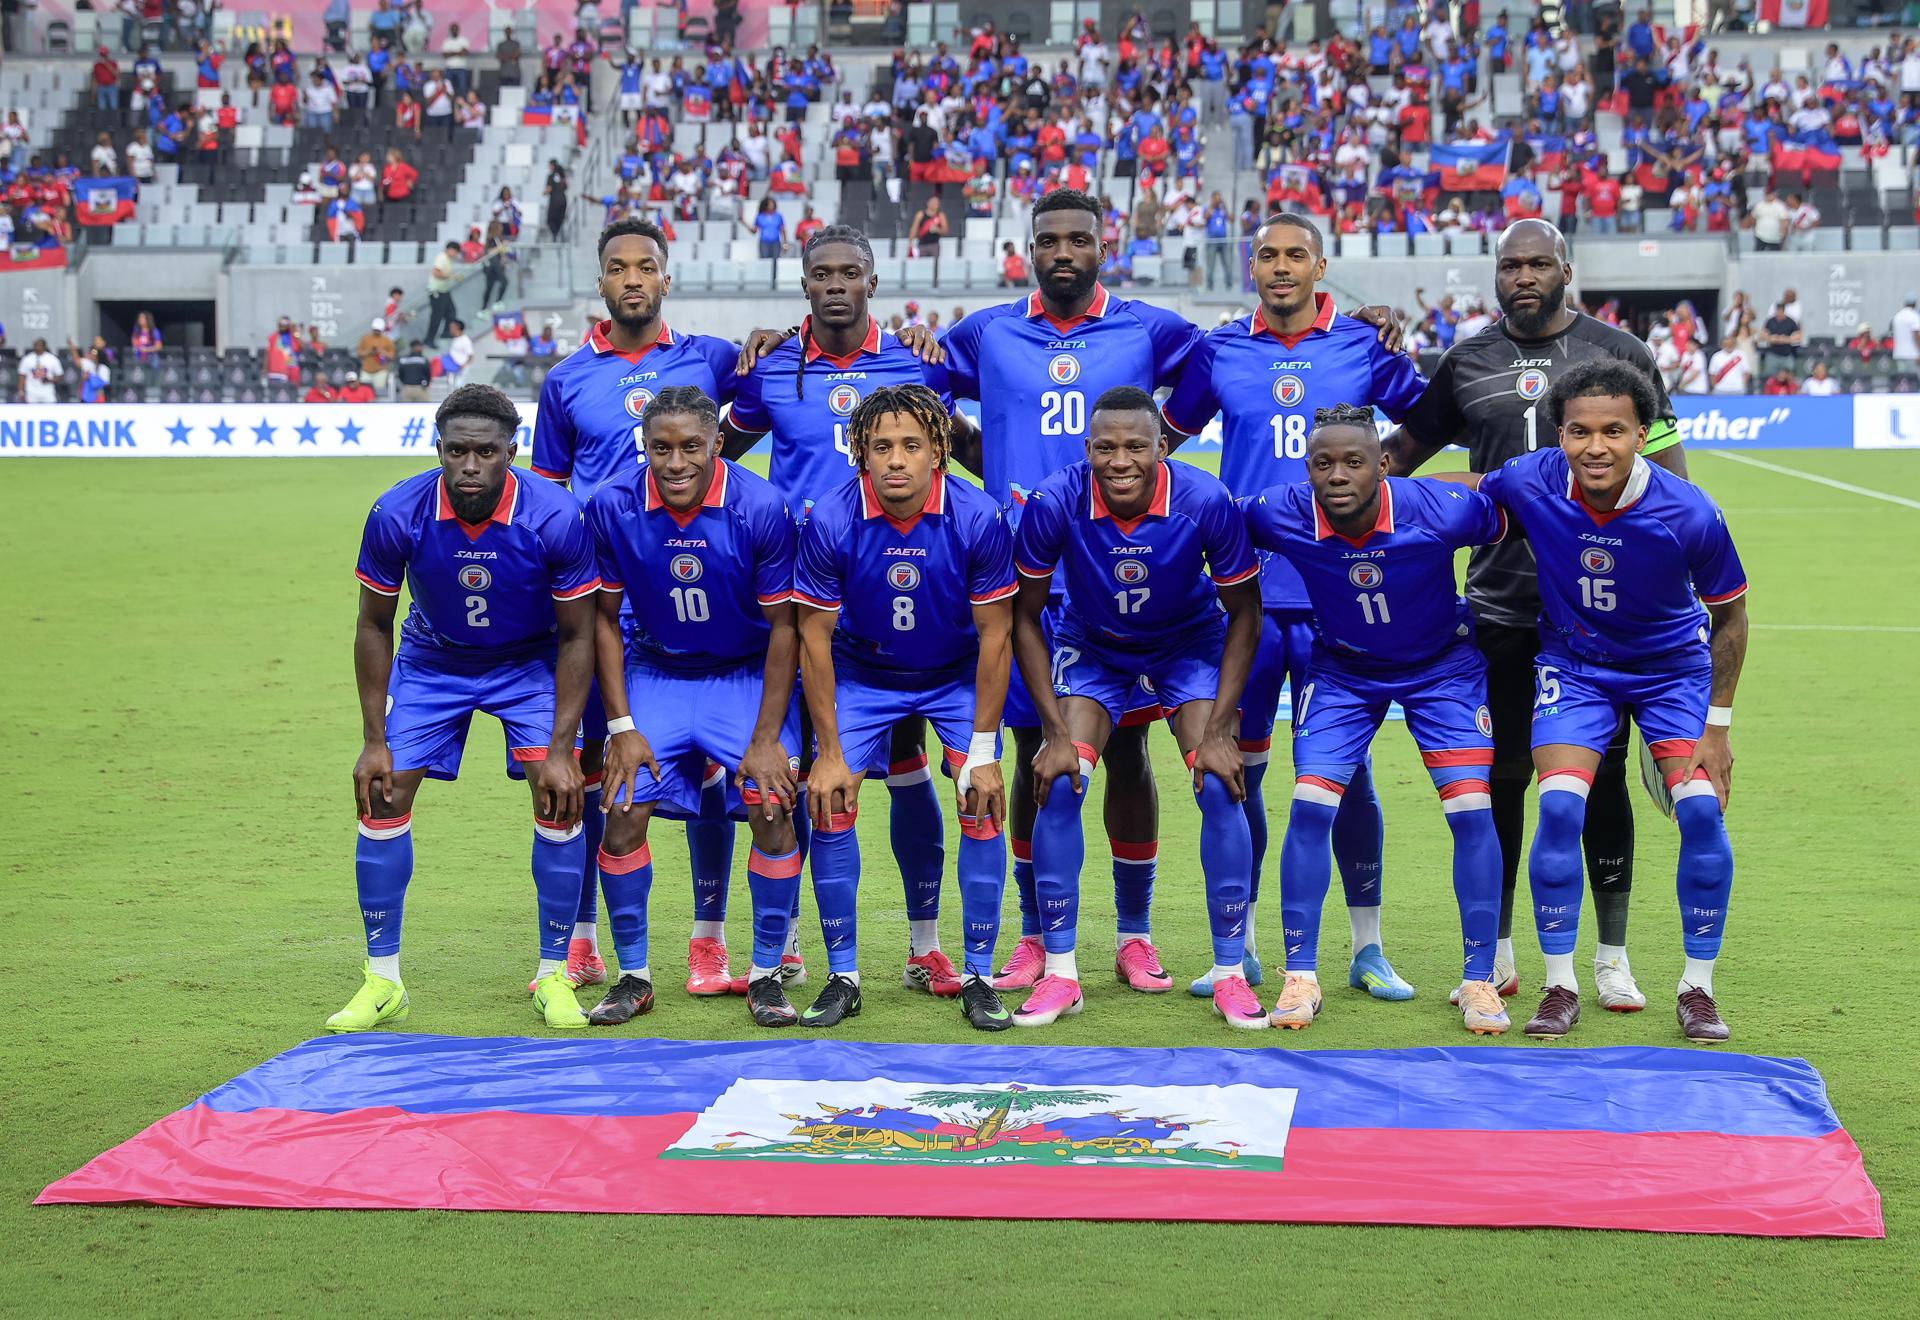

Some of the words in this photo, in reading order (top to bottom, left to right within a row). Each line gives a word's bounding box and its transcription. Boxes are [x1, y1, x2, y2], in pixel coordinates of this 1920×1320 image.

[1829, 308, 1859, 327] 120
[1045, 341, 1087, 349] SAETA
[1269, 361, 1312, 370] SAETA
[1509, 358, 1552, 368] SAETA
[617, 371, 658, 387] SAETA
[824, 372, 867, 381] SAETA
[1040, 391, 1085, 436] 20
[1, 420, 137, 447] NIBANK
[1523, 406, 1537, 451] 1
[1269, 414, 1307, 459] 18
[664, 539, 707, 548] SAETA
[1578, 533, 1623, 546] SAETA
[883, 547, 927, 557] SAETA
[1108, 545, 1153, 555] SAETA
[1341, 549, 1386, 559] SAETA
[453, 551, 498, 560] SAETA
[1577, 576, 1617, 612] 15
[669, 587, 710, 622] 10
[1114, 587, 1150, 614] 17
[465, 596, 490, 627] 2
[1356, 592, 1391, 624] 11
[892, 596, 915, 631] 8
[1356, 862, 1379, 871] FHF
[1599, 857, 1624, 866] FHF
[698, 878, 719, 887] FHF
[919, 881, 939, 889] FHF
[1048, 899, 1070, 909] FHF
[1226, 901, 1247, 913] FHF
[1541, 905, 1567, 914] FHF
[1693, 907, 1718, 917] FHF
[363, 910, 386, 920] FHF
[550, 921, 570, 931] FHF
[823, 918, 842, 928] FHF
[972, 923, 994, 931] FHF
[1285, 928, 1303, 938] FHF
[1465, 938, 1481, 947] FHF
